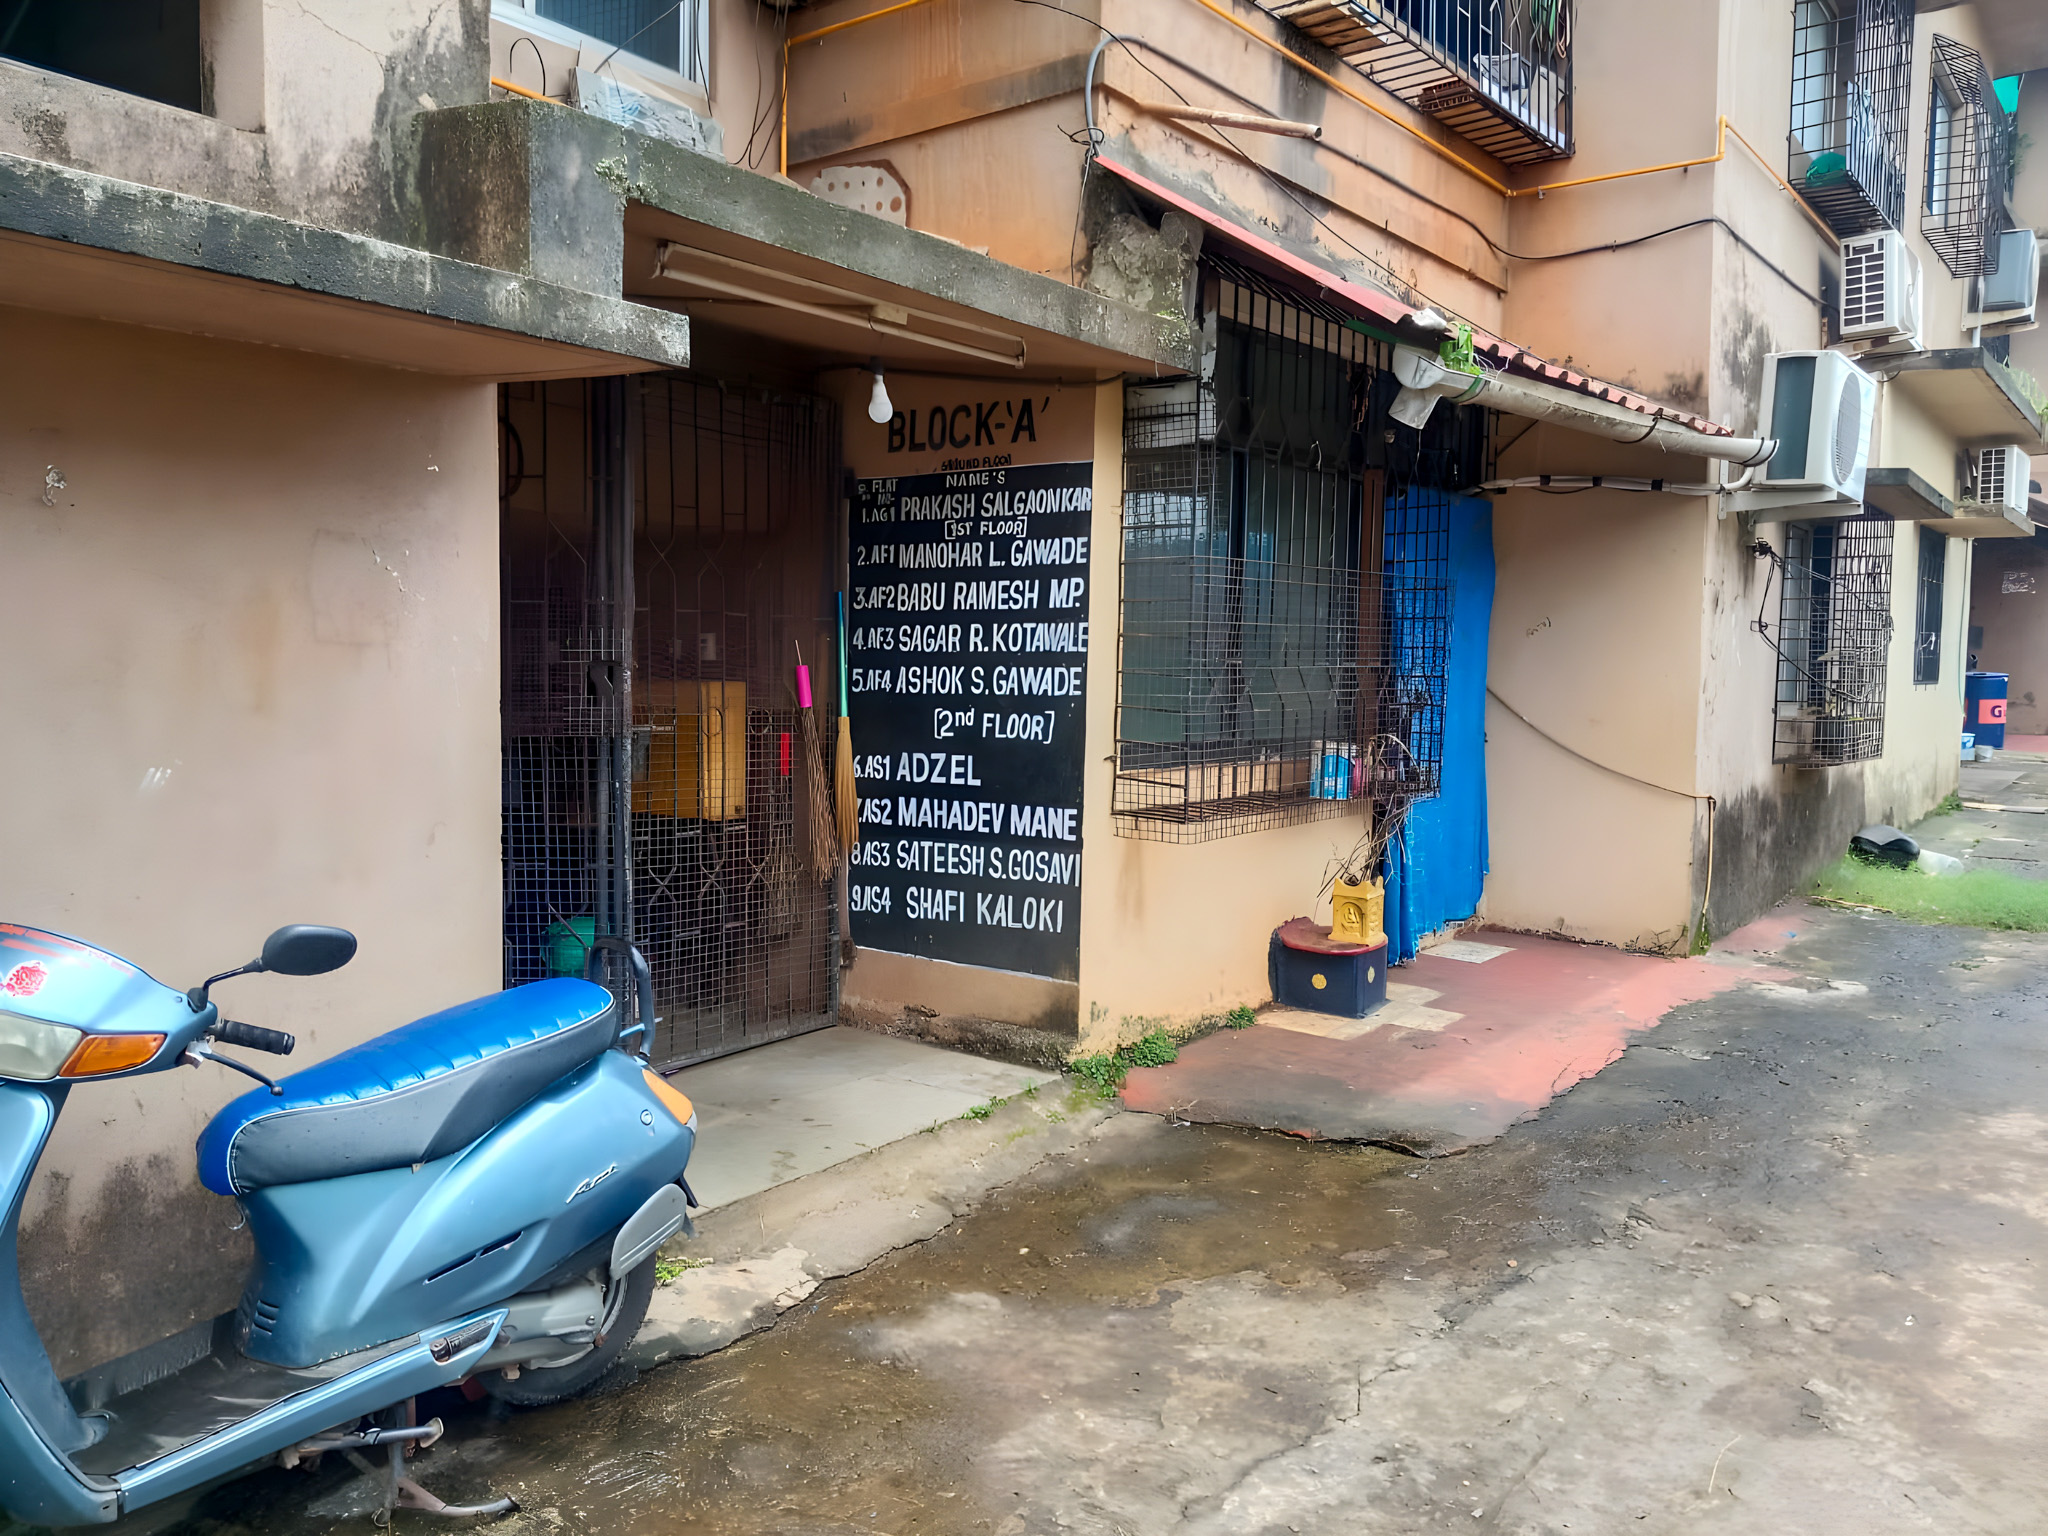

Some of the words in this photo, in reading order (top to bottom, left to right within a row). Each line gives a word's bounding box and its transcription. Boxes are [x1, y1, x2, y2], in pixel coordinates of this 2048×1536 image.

[901, 493, 975, 521] PRAKASH
[981, 487, 1092, 517] SALGAONKAR
[899, 541, 982, 568] MANOHAR
[989, 541, 1006, 567] L.
[1011, 537, 1088, 567] GAWADE
[897, 582, 946, 611] BABU
[953, 579, 1039, 610] RAMESH
[899, 624, 962, 652] SAGAR
[992, 622, 1089, 652] KOTAWALE
[896, 666, 965, 694] ASHOK
[992, 666, 1082, 696] GAWADE
[897, 752, 982, 786] ADZEL
[898, 796, 1005, 834] MAHADEV
[1010, 804, 1078, 841] MANE
[897, 840, 984, 877] SATEESH
[906, 886, 965, 923] SHAFI
[976, 892, 1063, 933] KALOKI
